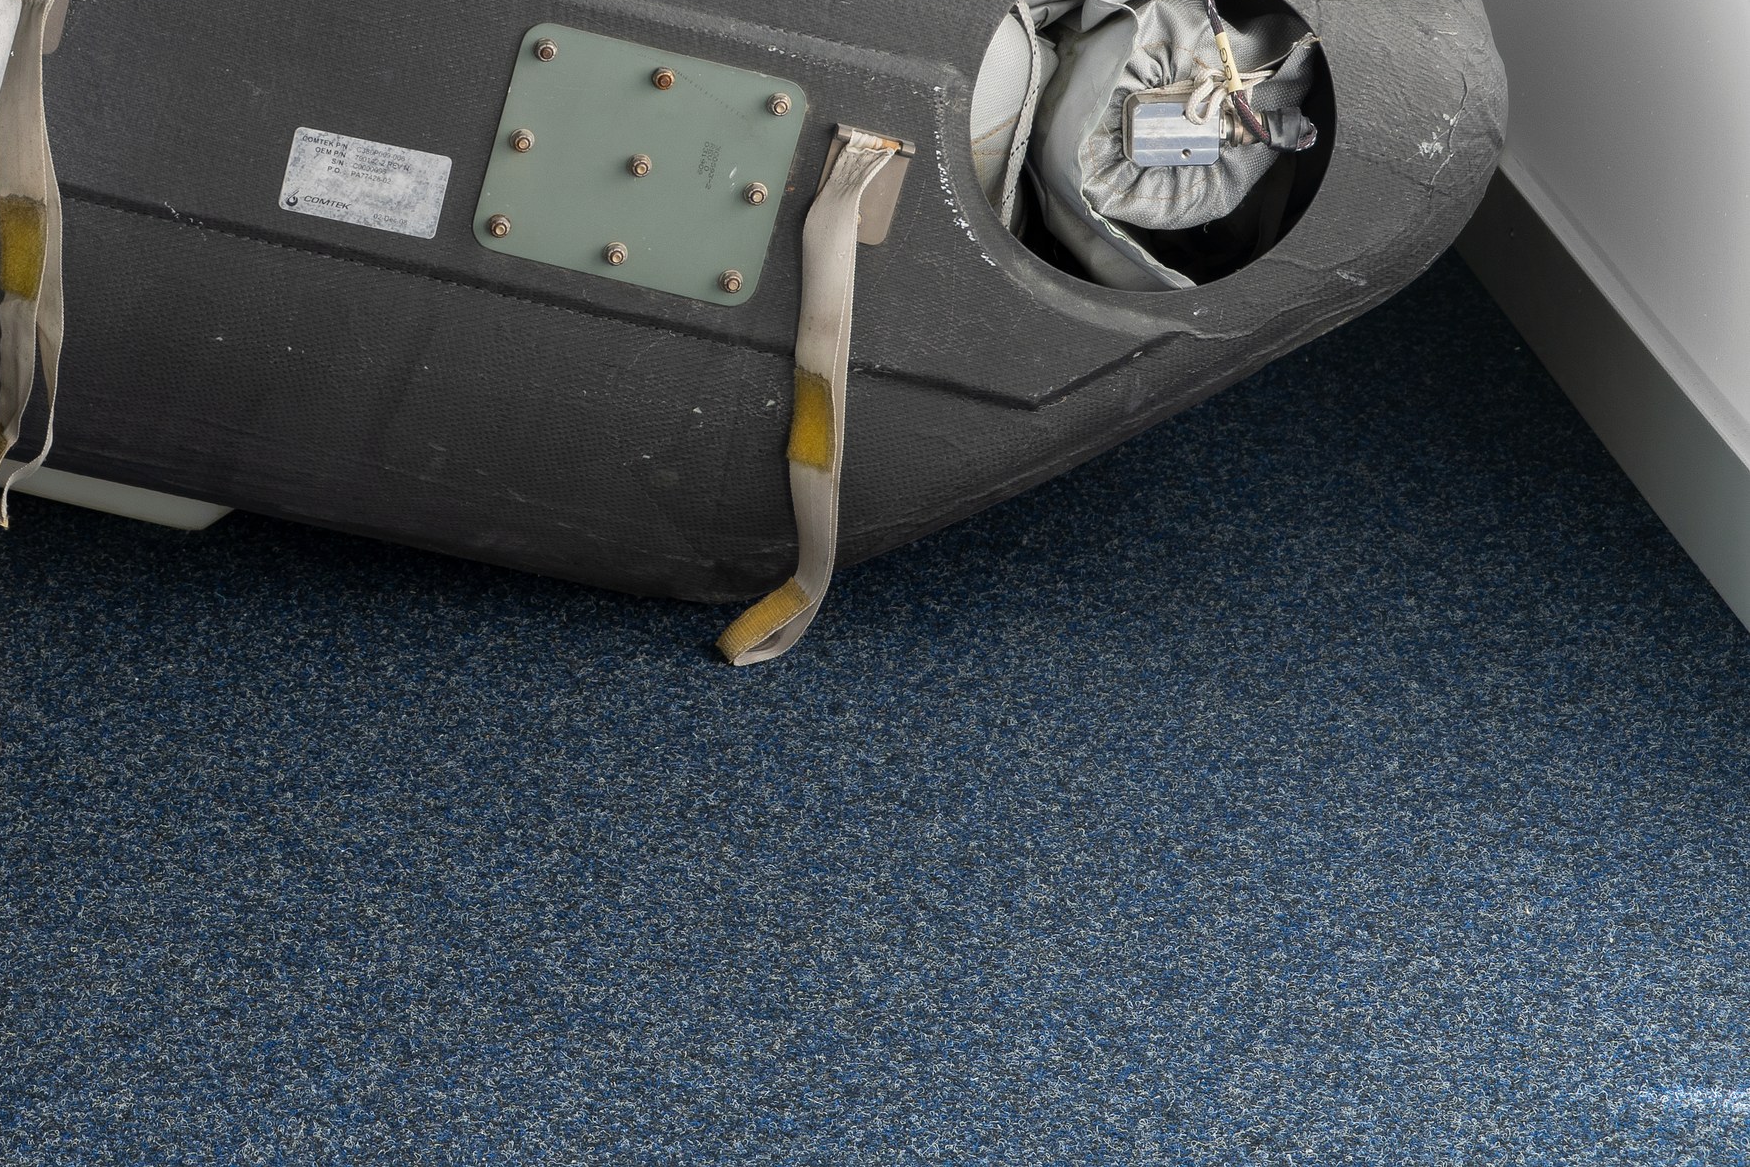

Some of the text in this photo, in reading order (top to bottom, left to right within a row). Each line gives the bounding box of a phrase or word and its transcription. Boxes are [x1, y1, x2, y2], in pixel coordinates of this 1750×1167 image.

[302, 135, 334, 148] COMTEK
[315, 146, 332, 155] OEM
[303, 195, 352, 210] COMTEK
